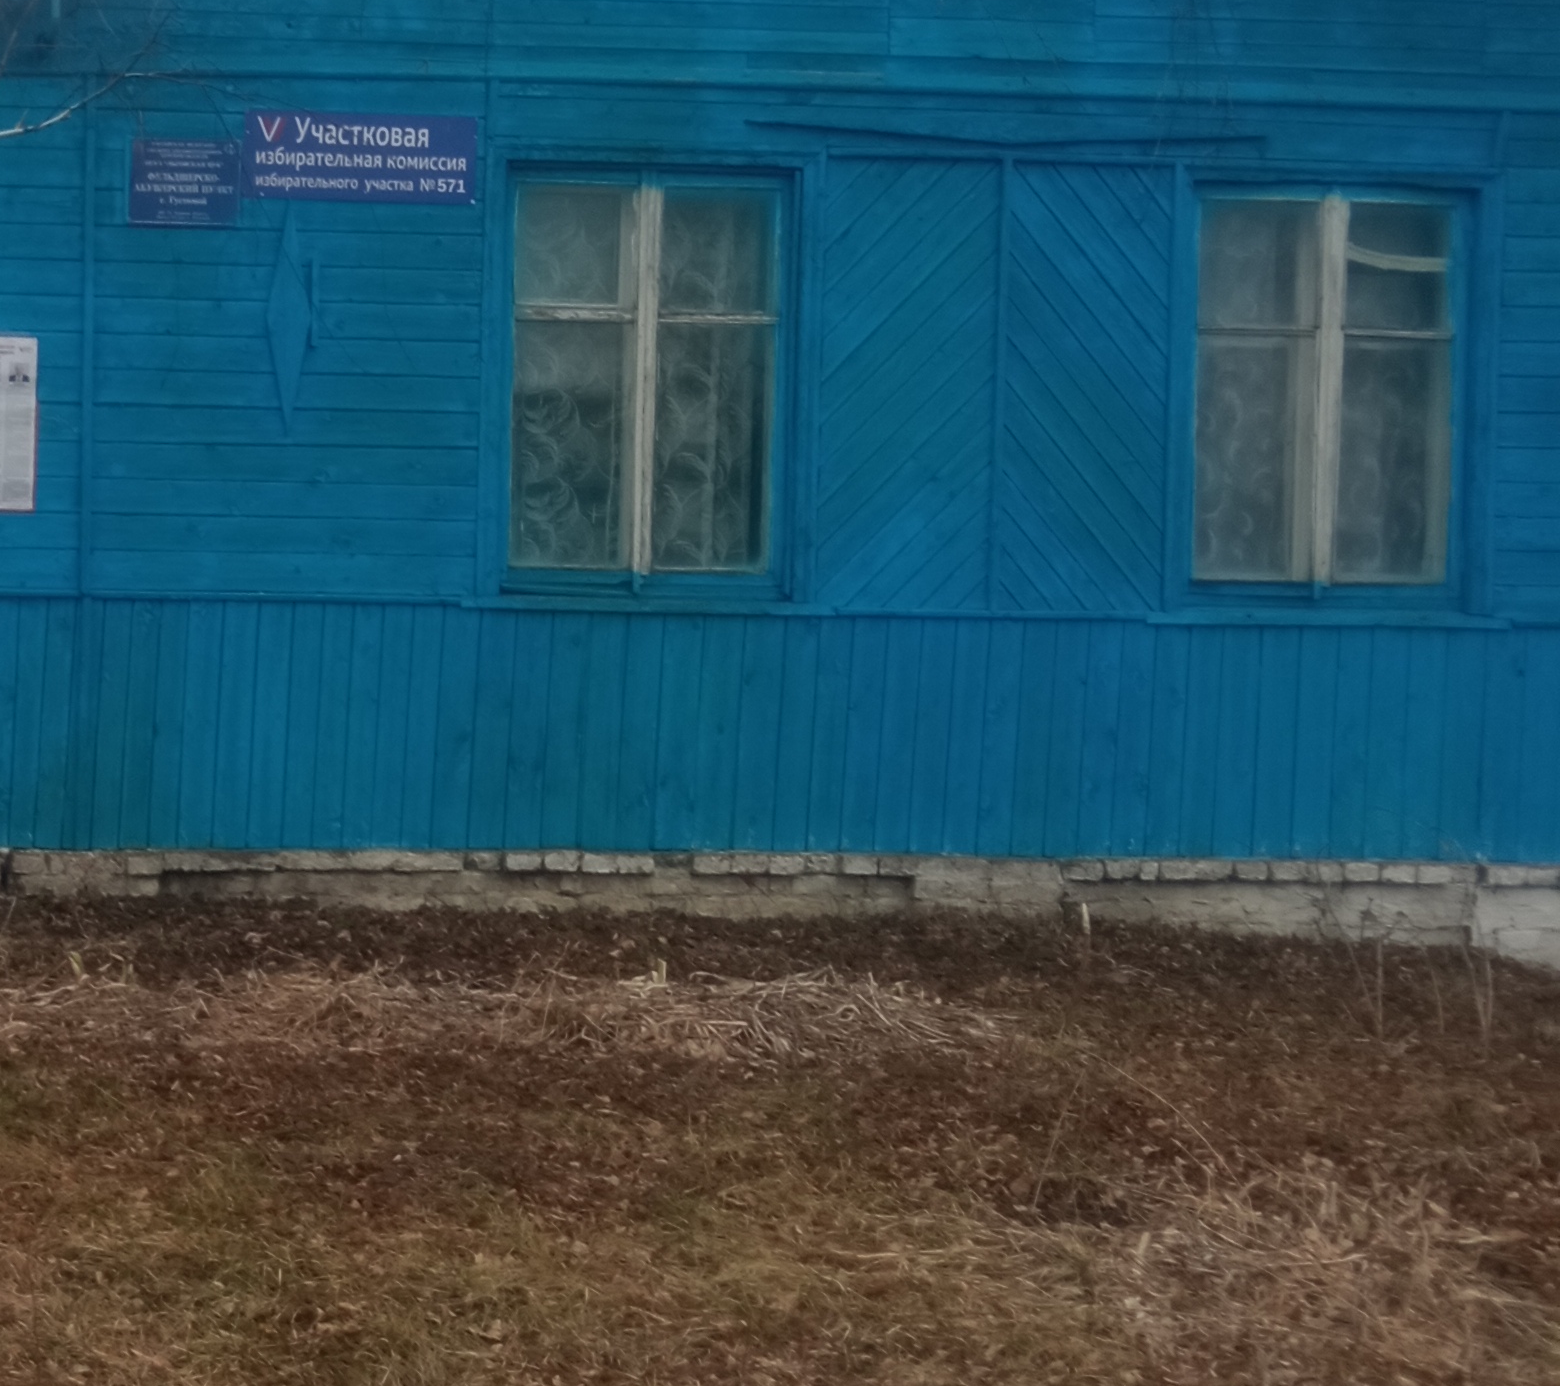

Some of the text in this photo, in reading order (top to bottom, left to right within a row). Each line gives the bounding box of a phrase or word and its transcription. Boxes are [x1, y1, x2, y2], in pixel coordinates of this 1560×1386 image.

[295, 116, 430, 148] Участковая
[255, 146, 467, 172] избирательная комиссия
[255, 173, 359, 191] избирательного
[364, 178, 414, 194] участка
